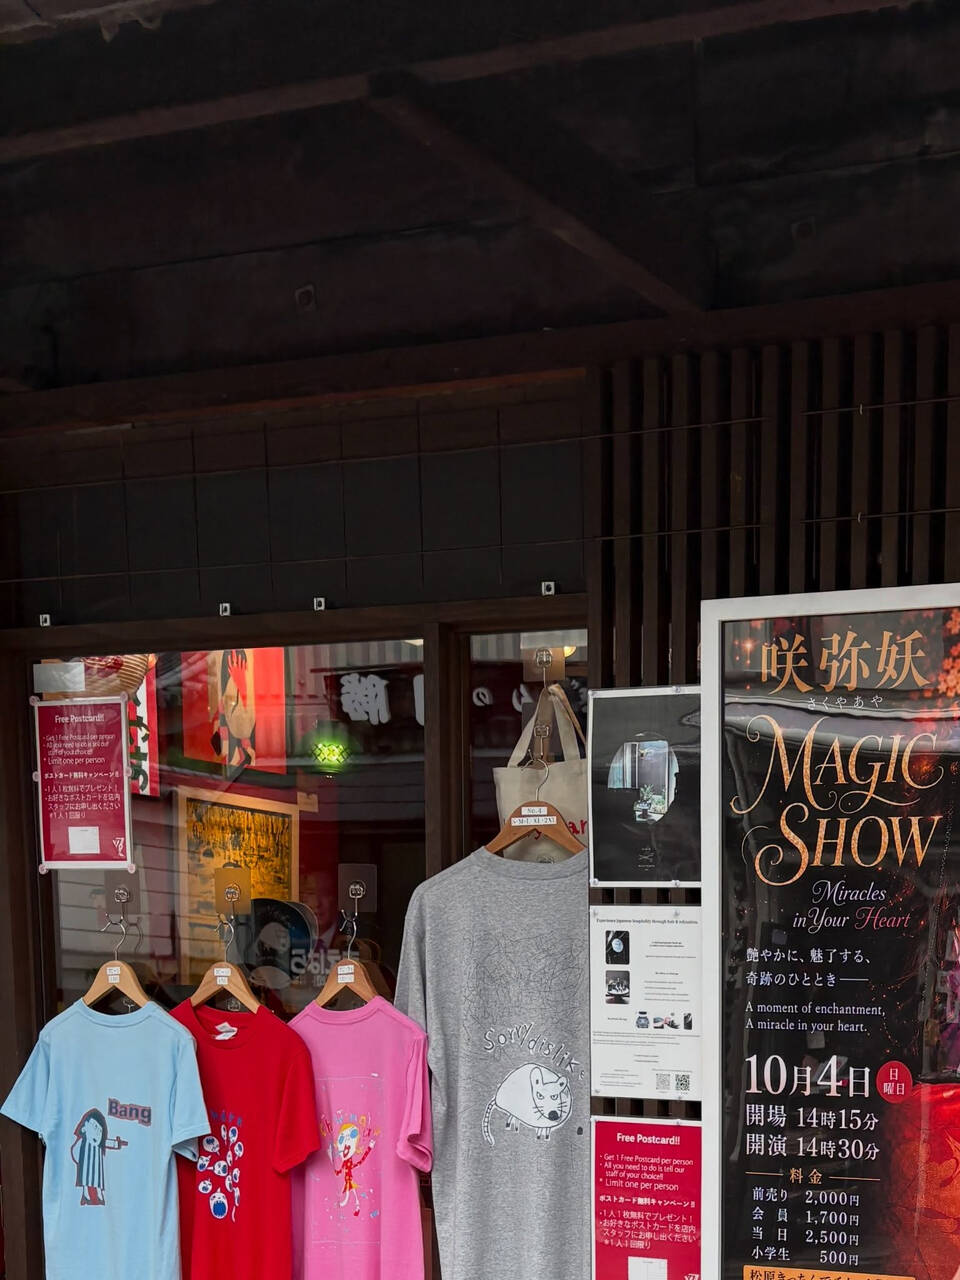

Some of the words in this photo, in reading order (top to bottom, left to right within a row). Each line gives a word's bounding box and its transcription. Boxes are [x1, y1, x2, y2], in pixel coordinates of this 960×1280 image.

[761, 630, 931, 695] 咲弥妖
[807, 695, 883, 710] さくやあや
[55, 715, 69, 723] Free
[730, 714, 945, 815] MAGIC
[748, 802, 943, 887] SHOW
[812, 879, 887, 904] Miracles
[793, 911, 807, 929] in
[807, 906, 850, 934] Your
[854, 905, 912, 930] Heart
[745, 1001, 754, 1013] A
[757, 1003, 798, 1014] moment
[801, 1002, 813, 1014] of
[815, 1004, 886, 1017] enchantment,
[745, 1018, 754, 1029] A
[757, 1018, 795, 1030] miracle
[798, 1019, 808, 1031] in
[811, 1022, 834, 1034] your
[837, 1021, 868, 1032] heart.
[483, 1021, 535, 1053] Sorry
[745, 1054, 870, 1098] 10月4日
[108, 1098, 152, 1126] Bang
[746, 1104, 787, 1127] 開場
[797, 1107, 879, 1131] 14時15分
[617, 1132, 635, 1143] Free
[637, 1134, 680, 1145] Postcard!!
[746, 1133, 787, 1157] 開演
[797, 1136, 880, 1160] 14時30分
[604, 1153, 615, 1161] Get
[621, 1154, 633, 1162] Free
[635, 1155, 660, 1164] Postcard
[672, 1158, 693, 1166] person
[604, 1161, 612, 1169] All
[613, 1163, 624, 1171] you
[625, 1163, 640, 1171] need
[663, 1165, 673, 1173] tell
[605, 1169, 618, 1177] staff
[626, 1172, 640, 1180] your
[790, 1168, 822, 1184] 料金
[605, 1178, 623, 1187] Limit
[640, 1182, 652, 1190] per
[654, 1182, 679, 1191] person
[753, 1187, 788, 1202] 前売り
[805, 1191, 860, 1206] 2,000円
[805, 1211, 859, 1226] 1,700円
[805, 1230, 859, 1246] 2,500円
[751, 1246, 790, 1261] 小学生
[819, 1251, 859, 1266] 500円
